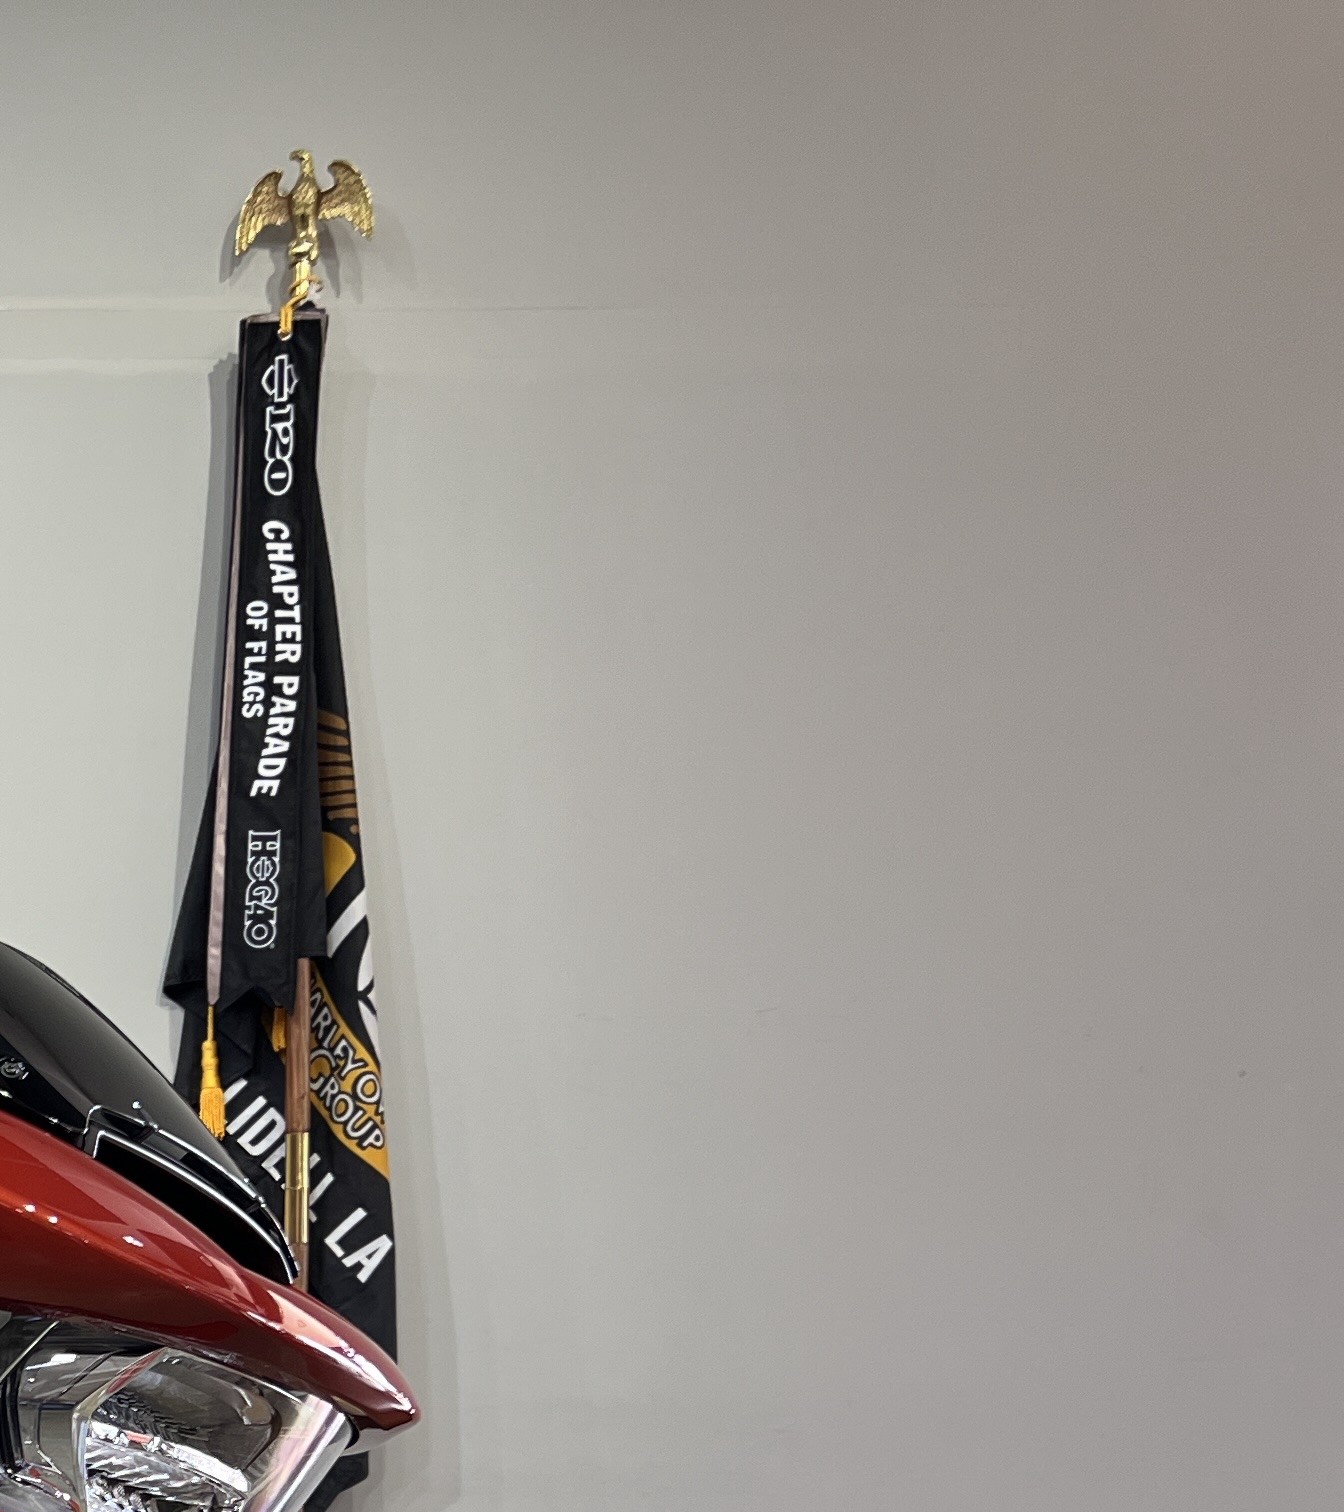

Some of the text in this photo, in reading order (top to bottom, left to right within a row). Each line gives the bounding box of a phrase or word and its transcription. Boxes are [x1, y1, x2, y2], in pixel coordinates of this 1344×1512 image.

[241, 600, 268, 719] OF FLAGS
[249, 519, 302, 798] CHAPTER PARADE
[323, 1206, 394, 1285] LA
